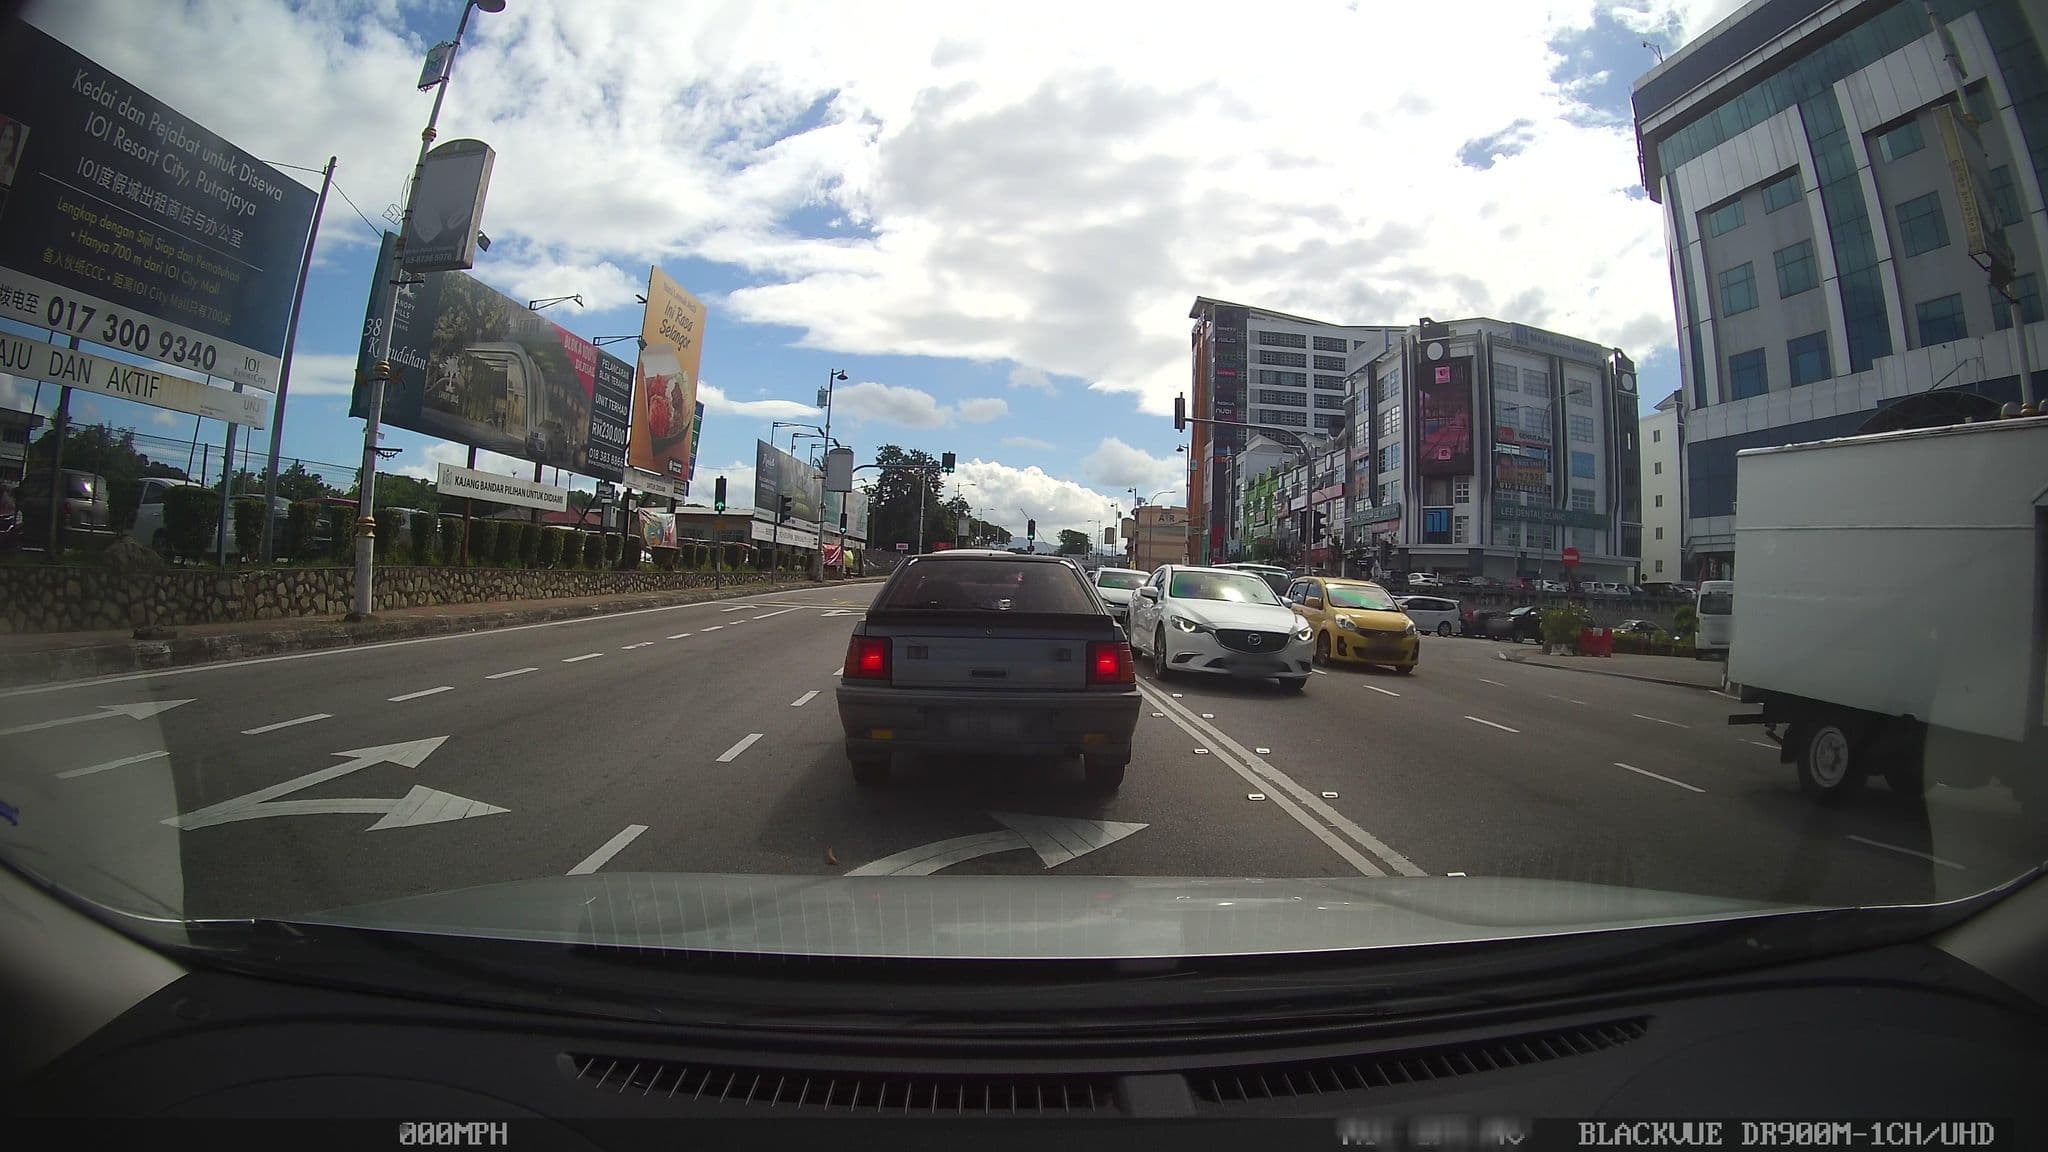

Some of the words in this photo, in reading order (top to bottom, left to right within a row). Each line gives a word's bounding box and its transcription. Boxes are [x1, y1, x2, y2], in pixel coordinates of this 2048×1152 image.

[72, 68, 118, 111] Kedai
[118, 95, 146, 127] dan
[148, 111, 201, 155] Pejabat
[202, 143, 237, 178] untuk
[239, 164, 284, 202] Disewa
[85, 111, 109, 142] IOI
[113, 127, 160, 167] Resort
[162, 153, 191, 187] City,
[195, 170, 257, 217] Putrajaya
[78, 229, 110, 255] Hanya
[111, 243, 132, 262] 700
[133, 253, 142, 265] m
[144, 258, 164, 274] dari
[182, 271, 199, 290] City
[201, 280, 221, 297] Mall
[99, 214, 135, 242] dengan
[137, 230, 154, 250] Sijil
[155, 238, 175, 259] Siap
[177, 248, 194, 265] dan
[47, 296, 97, 335] 017
[102, 314, 151, 352] 300
[158, 331, 217, 371] 9340
[364, 317, 383, 337] 38
[49, 351, 93, 386] DAN
[106, 366, 160, 399] AKTIF
[244, 356, 260, 373] IOI
[595, 392, 608, 408] UNIT
[608, 398, 628, 416] TERHAD
[592, 420, 626, 446] RM230,000
[454, 475, 480, 491] KAJANG
[480, 480, 505, 494] BANDAR
[504, 485, 526, 497] PILIHAN
[526, 488, 544, 500] UNTUK
